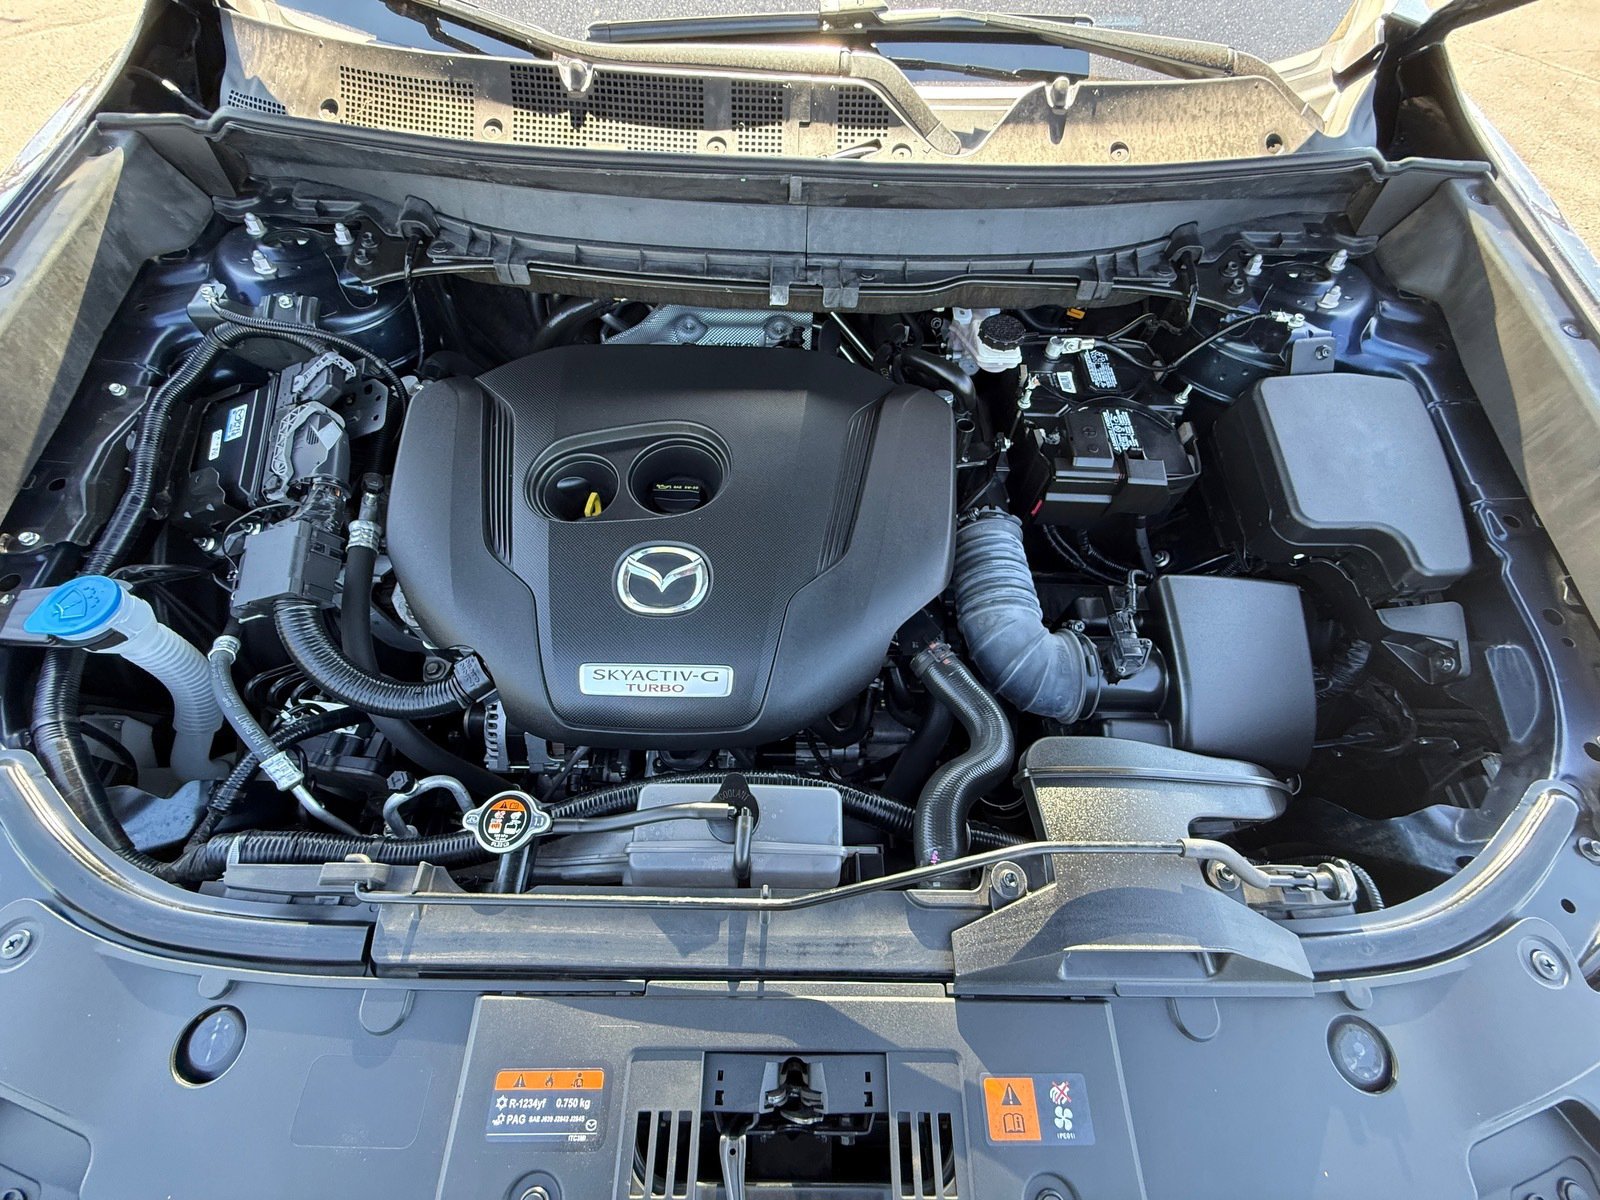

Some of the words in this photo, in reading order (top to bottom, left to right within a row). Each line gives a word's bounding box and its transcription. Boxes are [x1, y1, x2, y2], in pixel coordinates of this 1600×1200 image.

[592, 669, 719, 682] SKYACTIV-G
[626, 683, 685, 693] TURBO
[718, 788, 751, 801] COOLANT
[508, 1098, 547, 1110] R-1234yf
[556, 1098, 578, 1108] 0.750
[580, 1098, 591, 1109] kg
[506, 1114, 526, 1125] PAG
